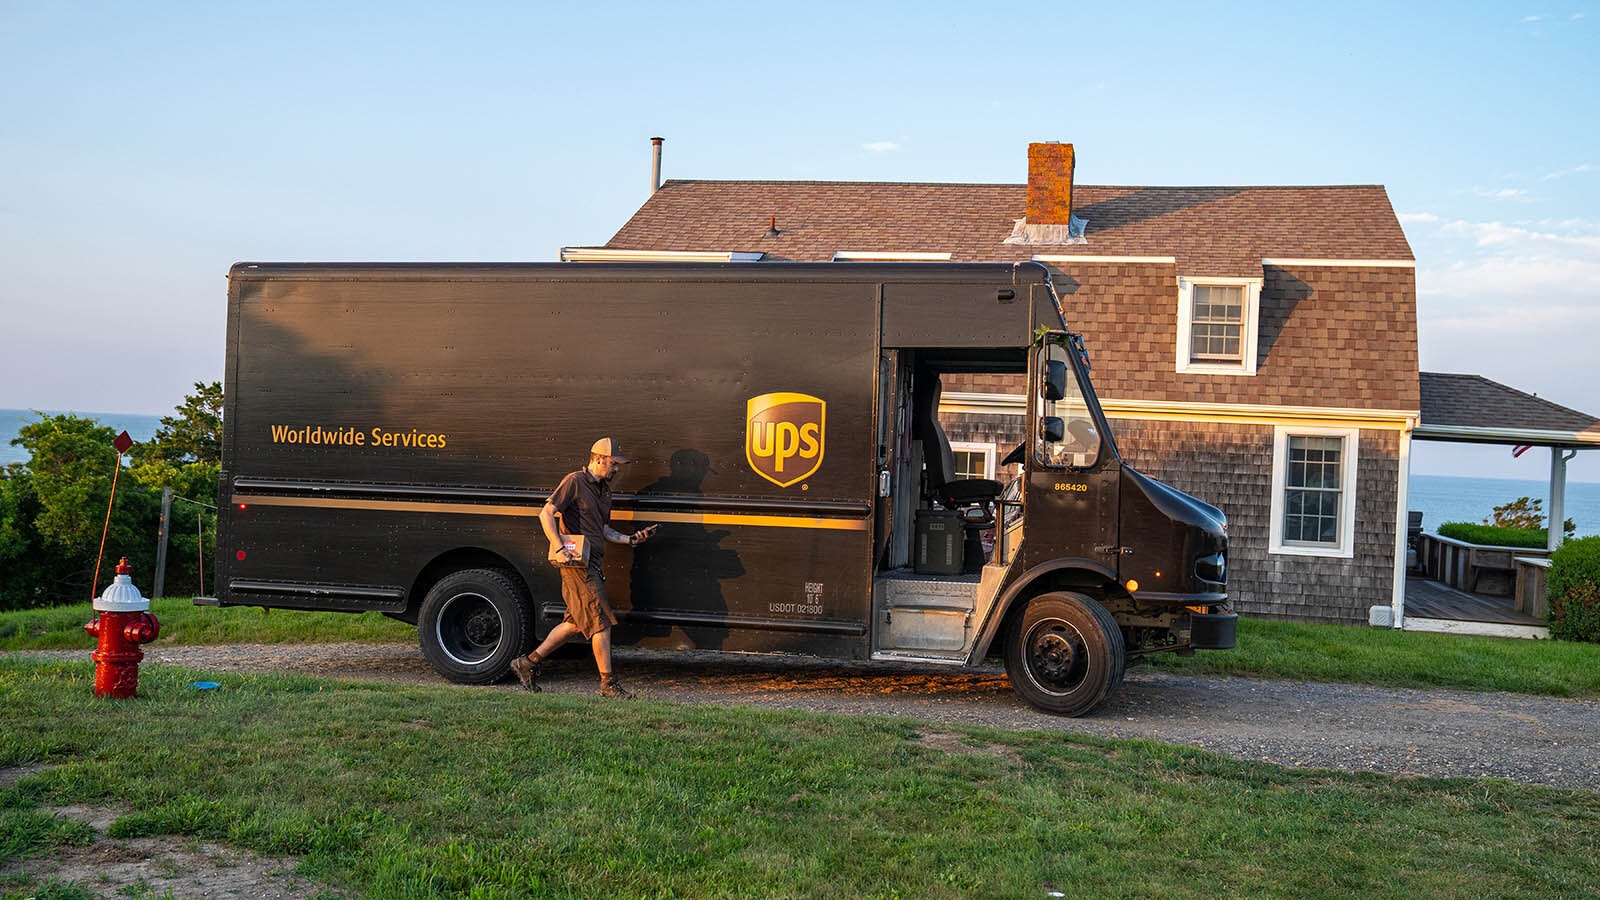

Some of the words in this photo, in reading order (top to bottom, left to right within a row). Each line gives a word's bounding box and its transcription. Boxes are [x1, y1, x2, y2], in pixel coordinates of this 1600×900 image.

[271, 425, 365, 446] Worldwide
[371, 427, 447, 448] Services
[752, 421, 819, 472] ups
[1054, 482, 1087, 492] 865420
[769, 602, 796, 613] USDOT
